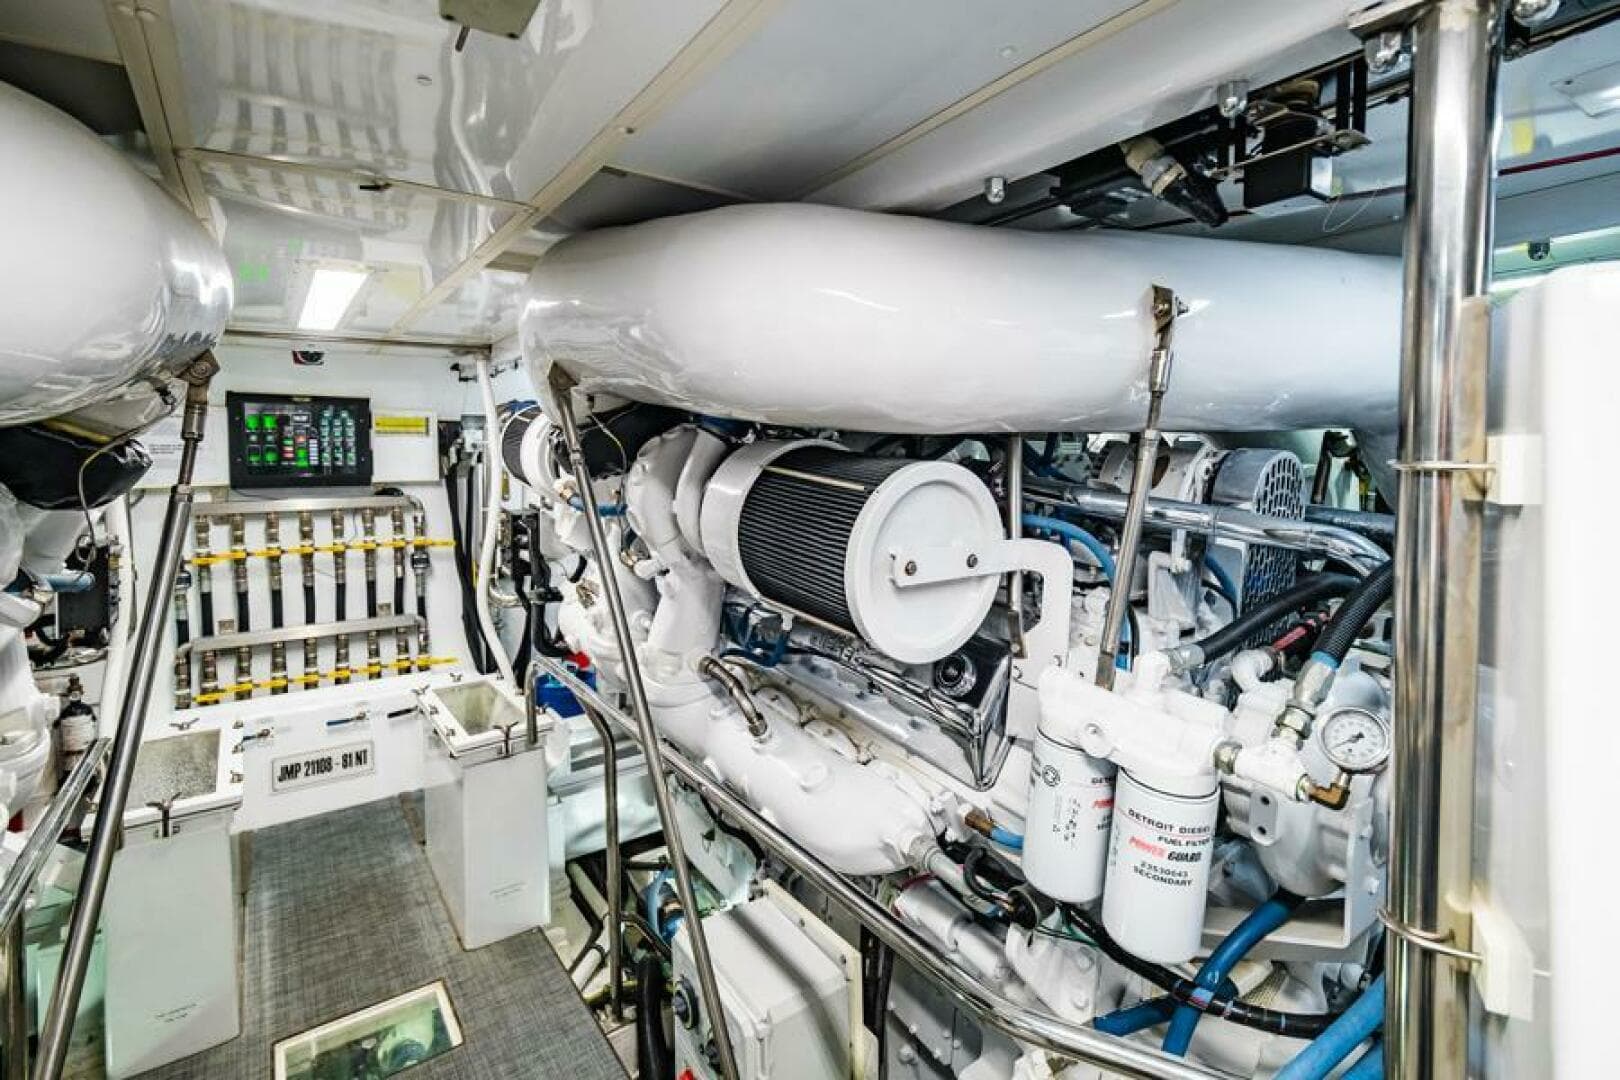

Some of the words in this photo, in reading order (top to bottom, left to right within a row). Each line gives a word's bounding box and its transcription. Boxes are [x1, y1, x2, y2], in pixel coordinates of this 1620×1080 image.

[278, 762, 301, 782] JMP
[1128, 808, 1174, 832] DETROIT
[1158, 836, 1182, 847] FUEL
[1133, 865, 1193, 886] SECONDARY
